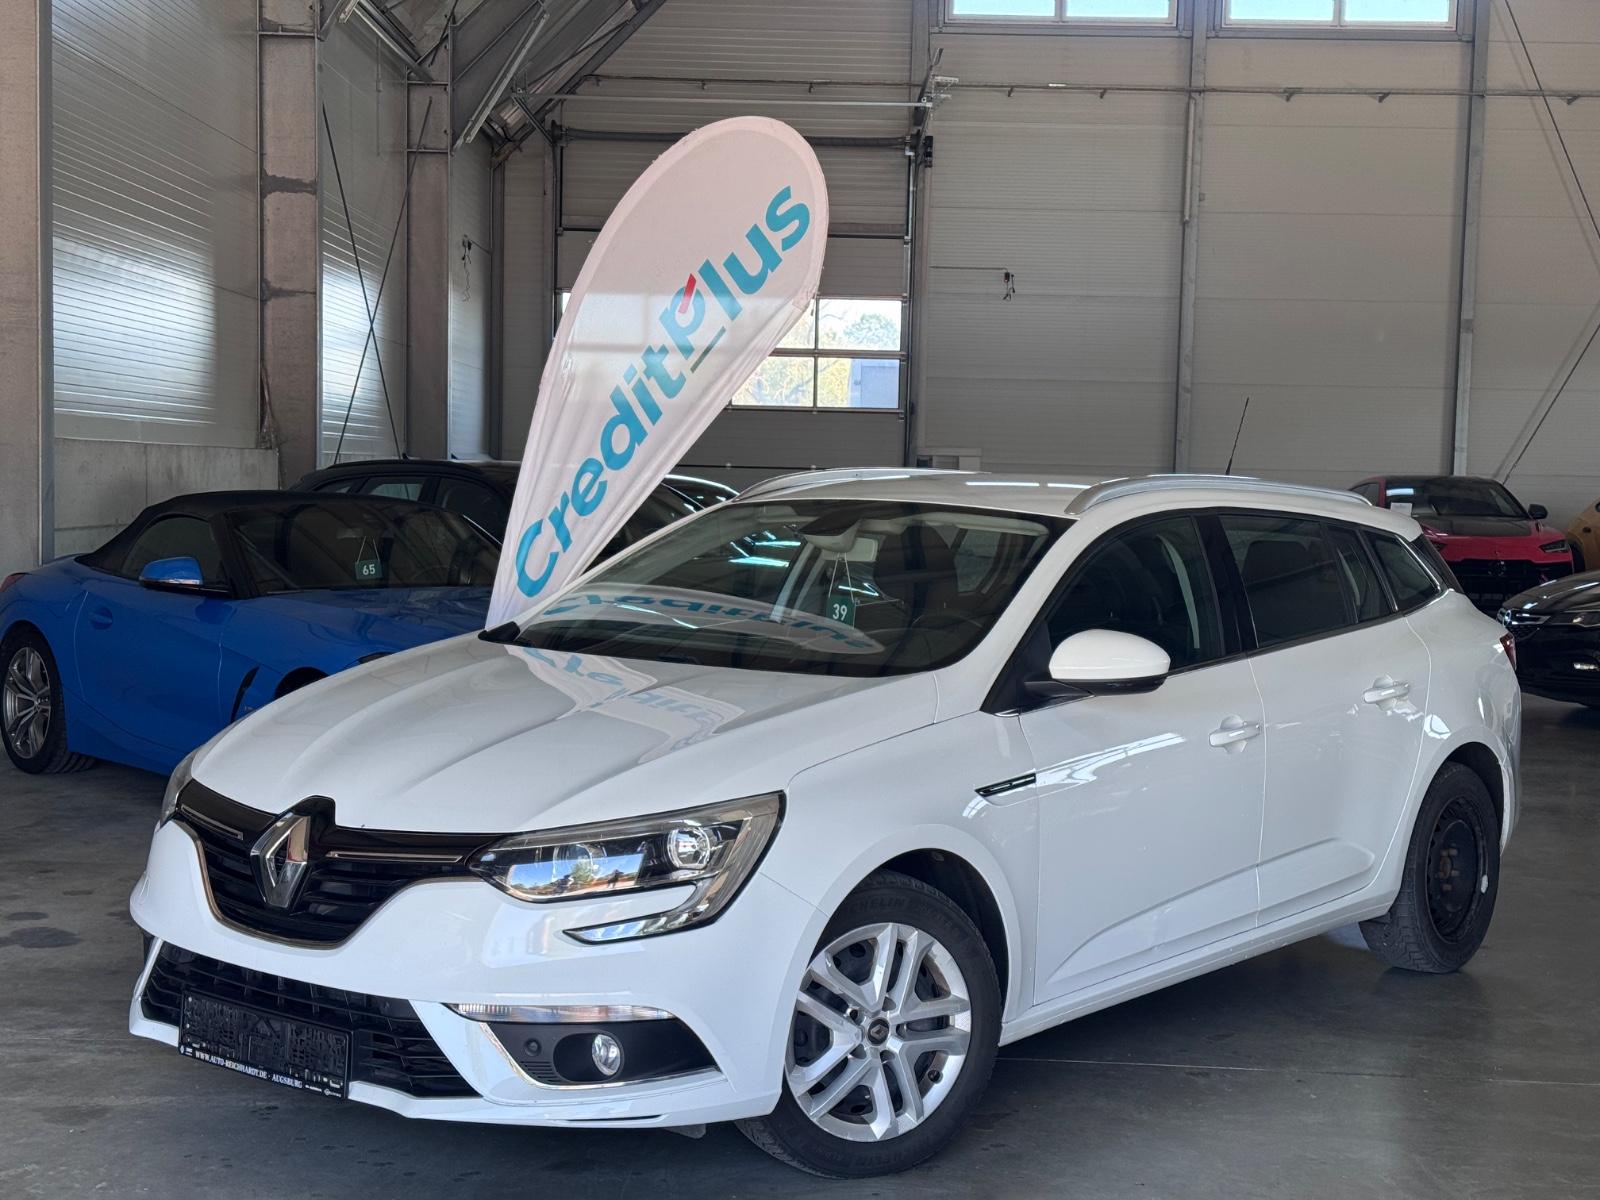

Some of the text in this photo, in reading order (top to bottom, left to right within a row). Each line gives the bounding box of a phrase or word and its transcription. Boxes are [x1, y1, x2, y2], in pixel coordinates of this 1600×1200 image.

[362, 563, 376, 576] 65
[832, 603, 848, 621] 39
[271, 1073, 303, 1089] AUGSBURG
